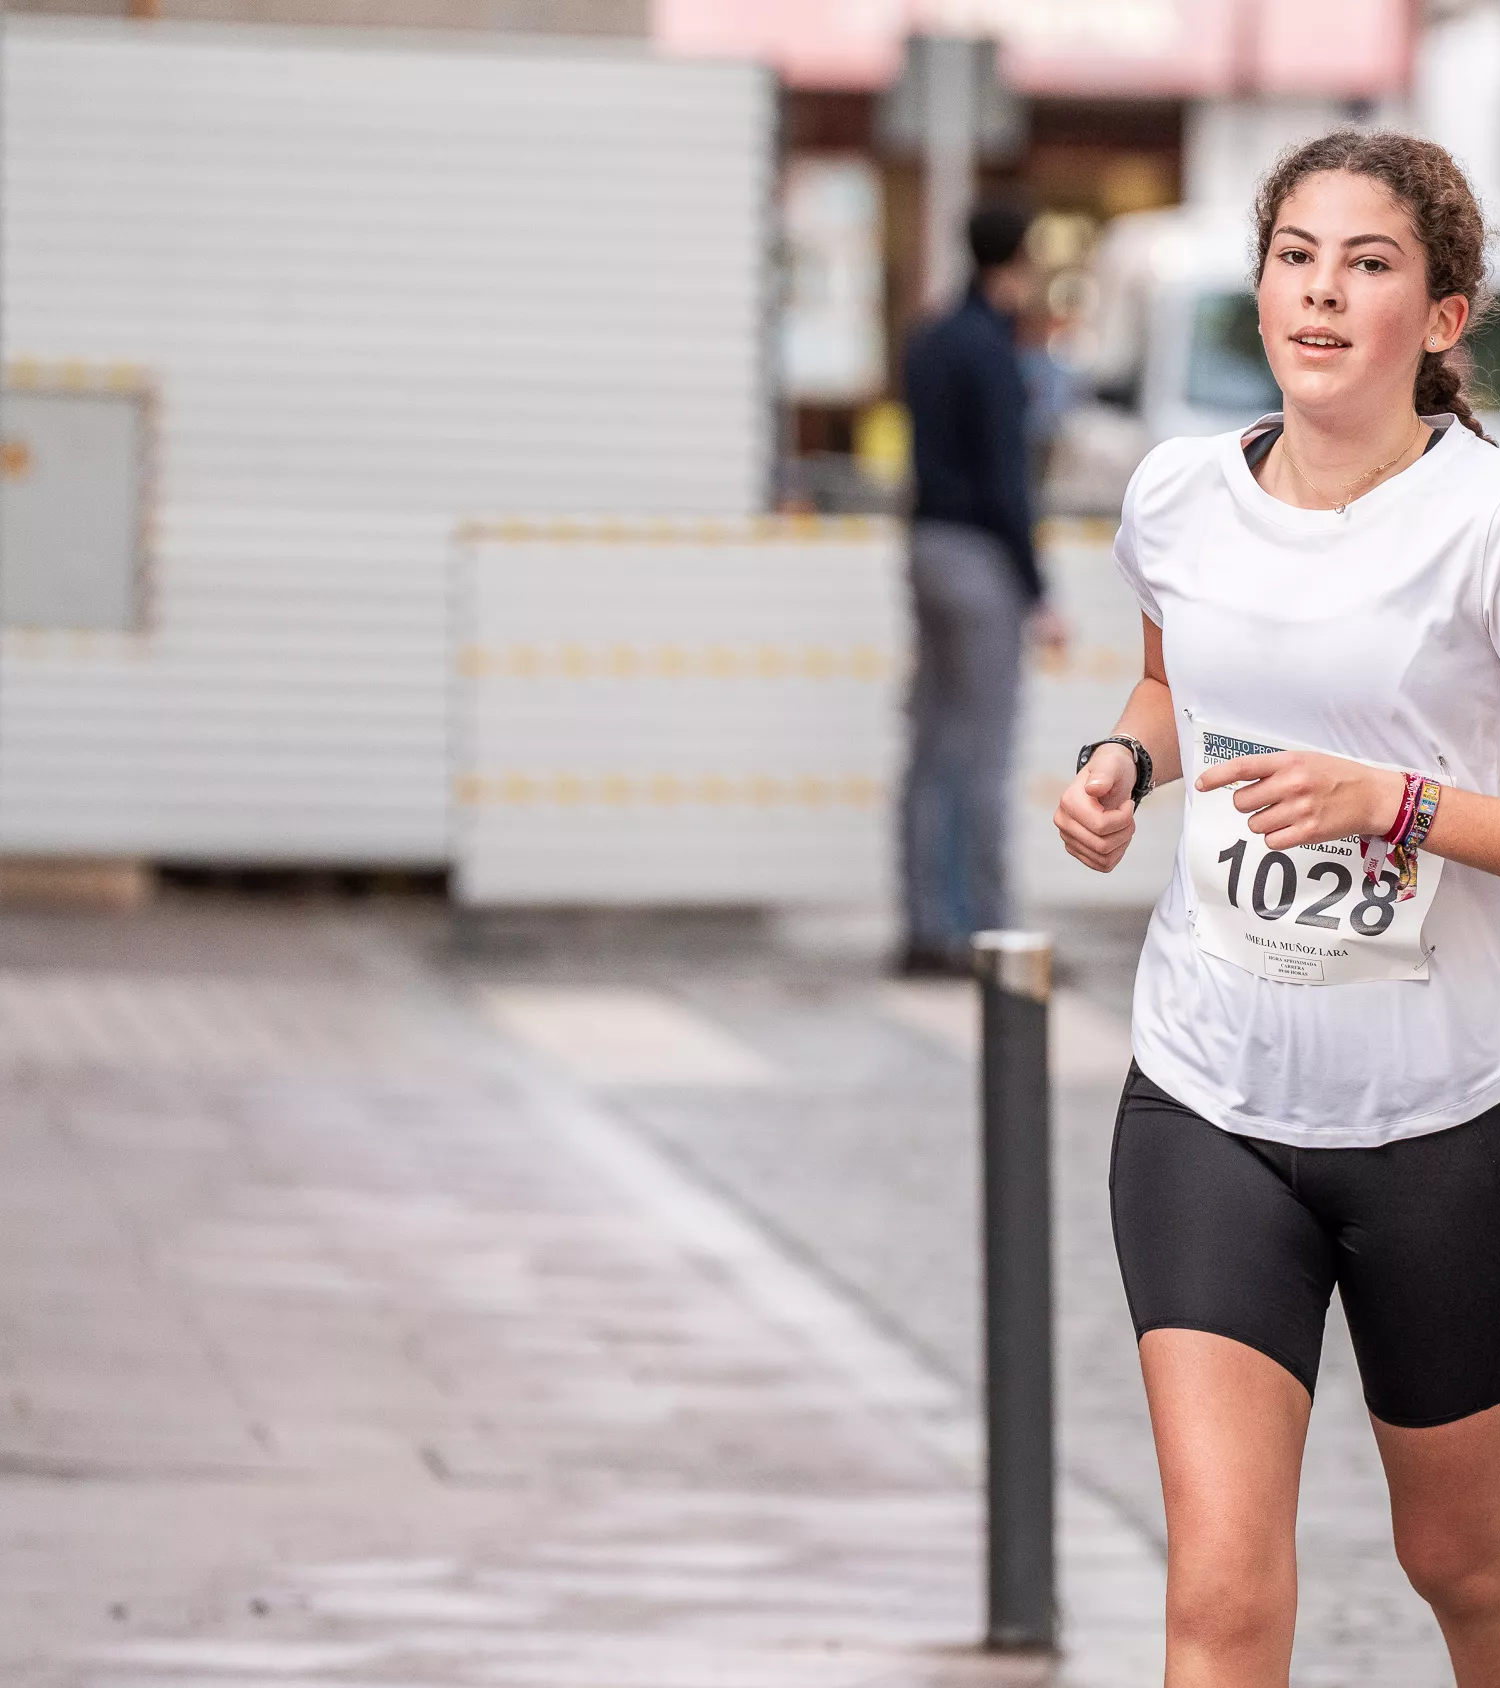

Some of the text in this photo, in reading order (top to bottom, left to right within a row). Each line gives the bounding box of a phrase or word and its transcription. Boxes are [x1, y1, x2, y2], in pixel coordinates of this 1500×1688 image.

[1203, 733, 1250, 752] CIRCUITO
[1217, 838, 1401, 937] 1028
[1244, 932, 1349, 957] AMELIA MUÑOZ LARA
[1280, 963, 1305, 971] CARRERA
